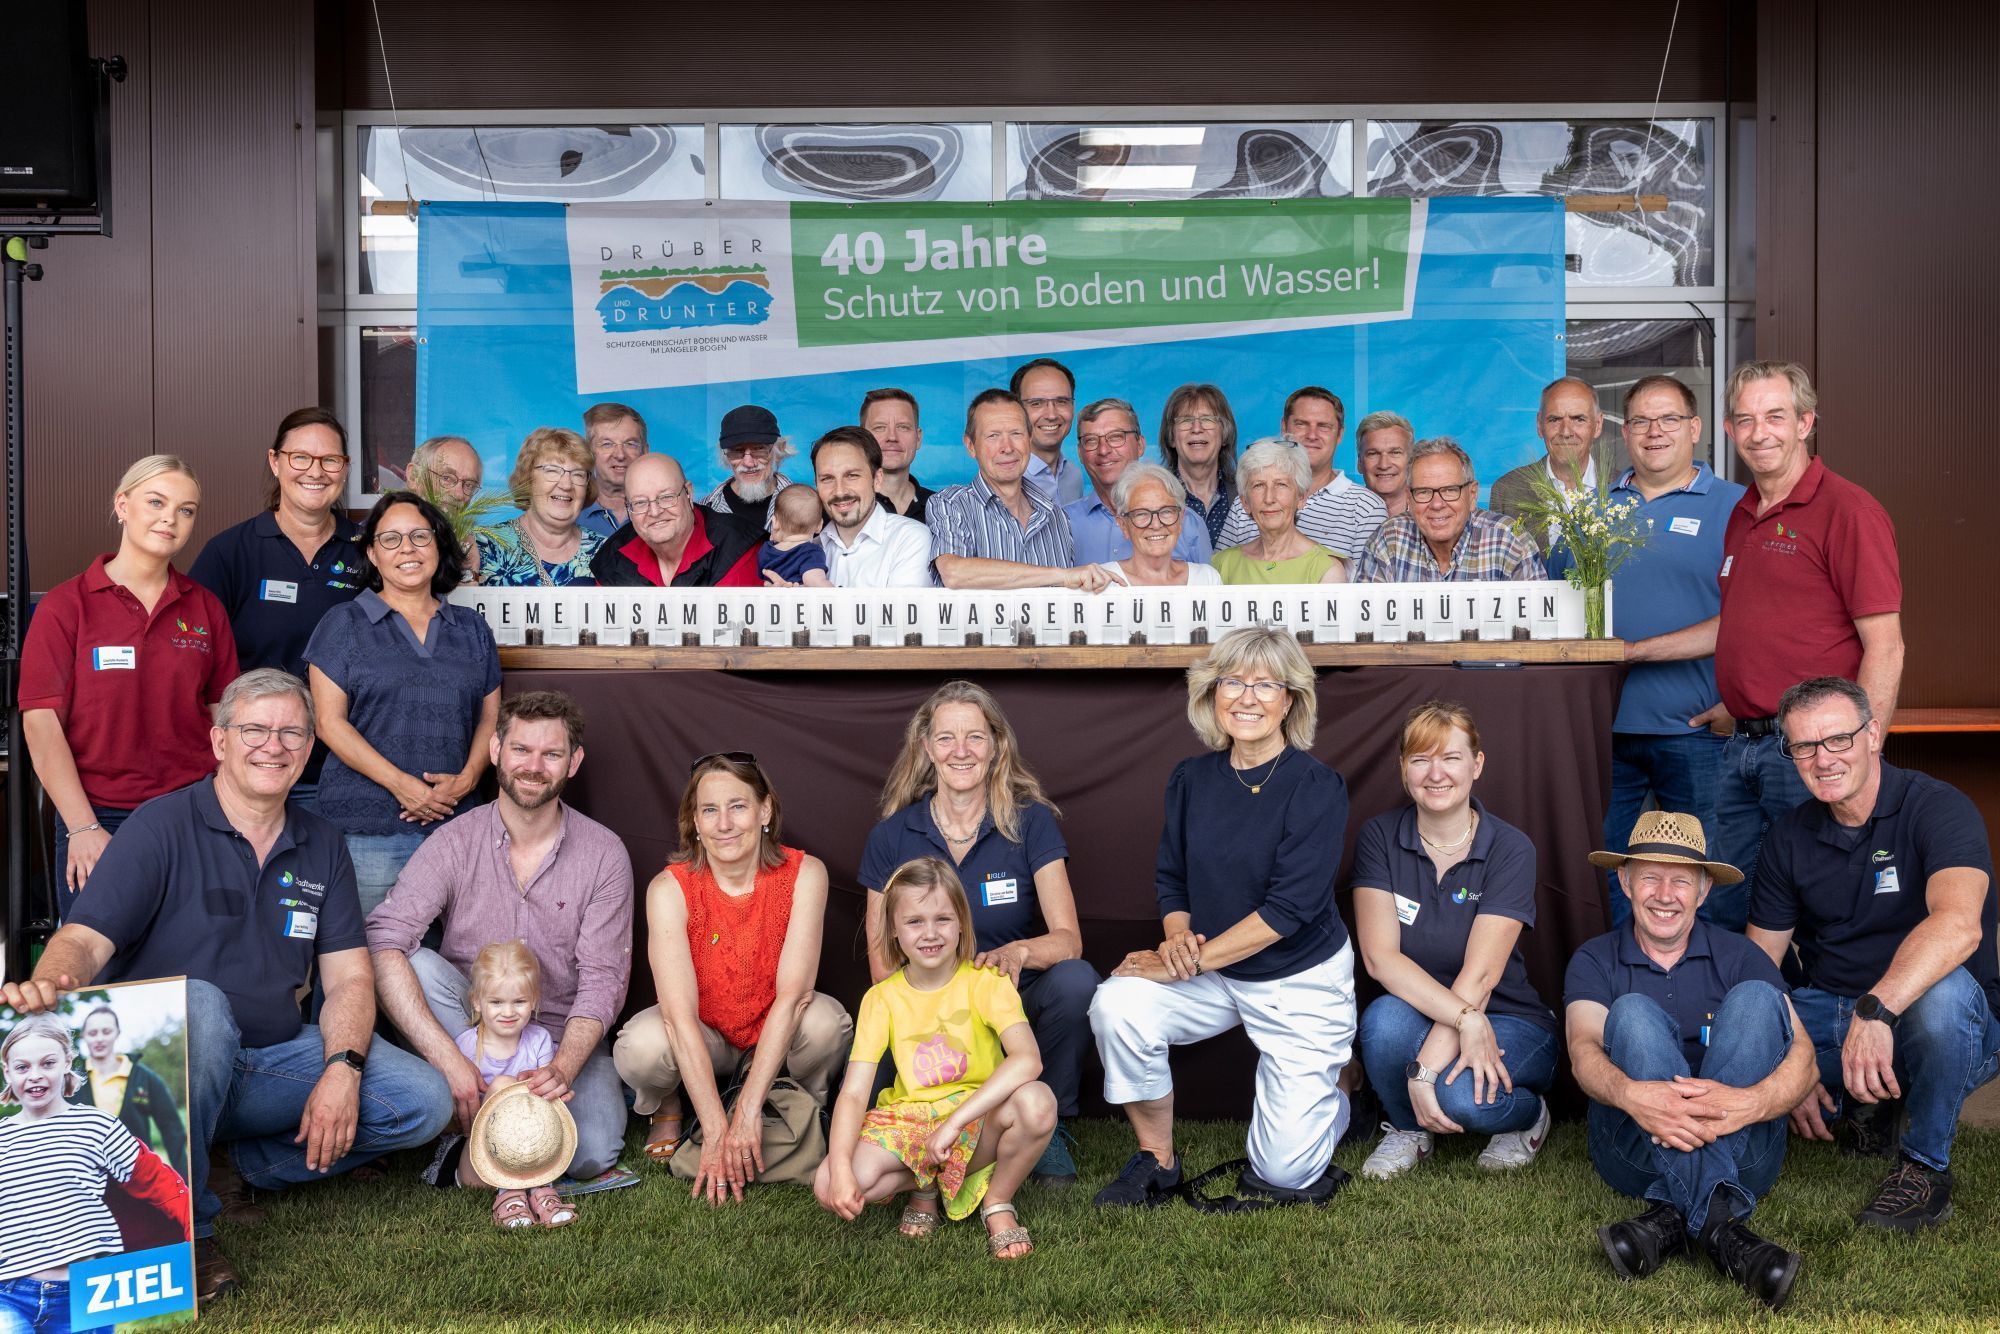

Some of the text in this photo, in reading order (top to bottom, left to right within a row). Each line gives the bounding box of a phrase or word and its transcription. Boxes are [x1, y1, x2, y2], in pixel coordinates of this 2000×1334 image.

[600, 238, 763, 261] DRÜBER
[821, 224, 1048, 276] 40 Jahre
[823, 256, 1380, 320] Schutz von Boden und Wasser!
[614, 299, 631, 308] UND
[614, 301, 759, 322] DRUNTER
[606, 334, 768, 349] SCHUTZGEMEINSCHAFT BODEN UND WASSER
[661, 345, 699, 354] LANGELER
[475, 594, 1554, 626] GEMEINSAM BODEN UND WASSER FÜR MORGEN SCHÜTZEN
[990, 871, 1006, 880] IGLU
[86, 1262, 184, 1314] ZIEL
